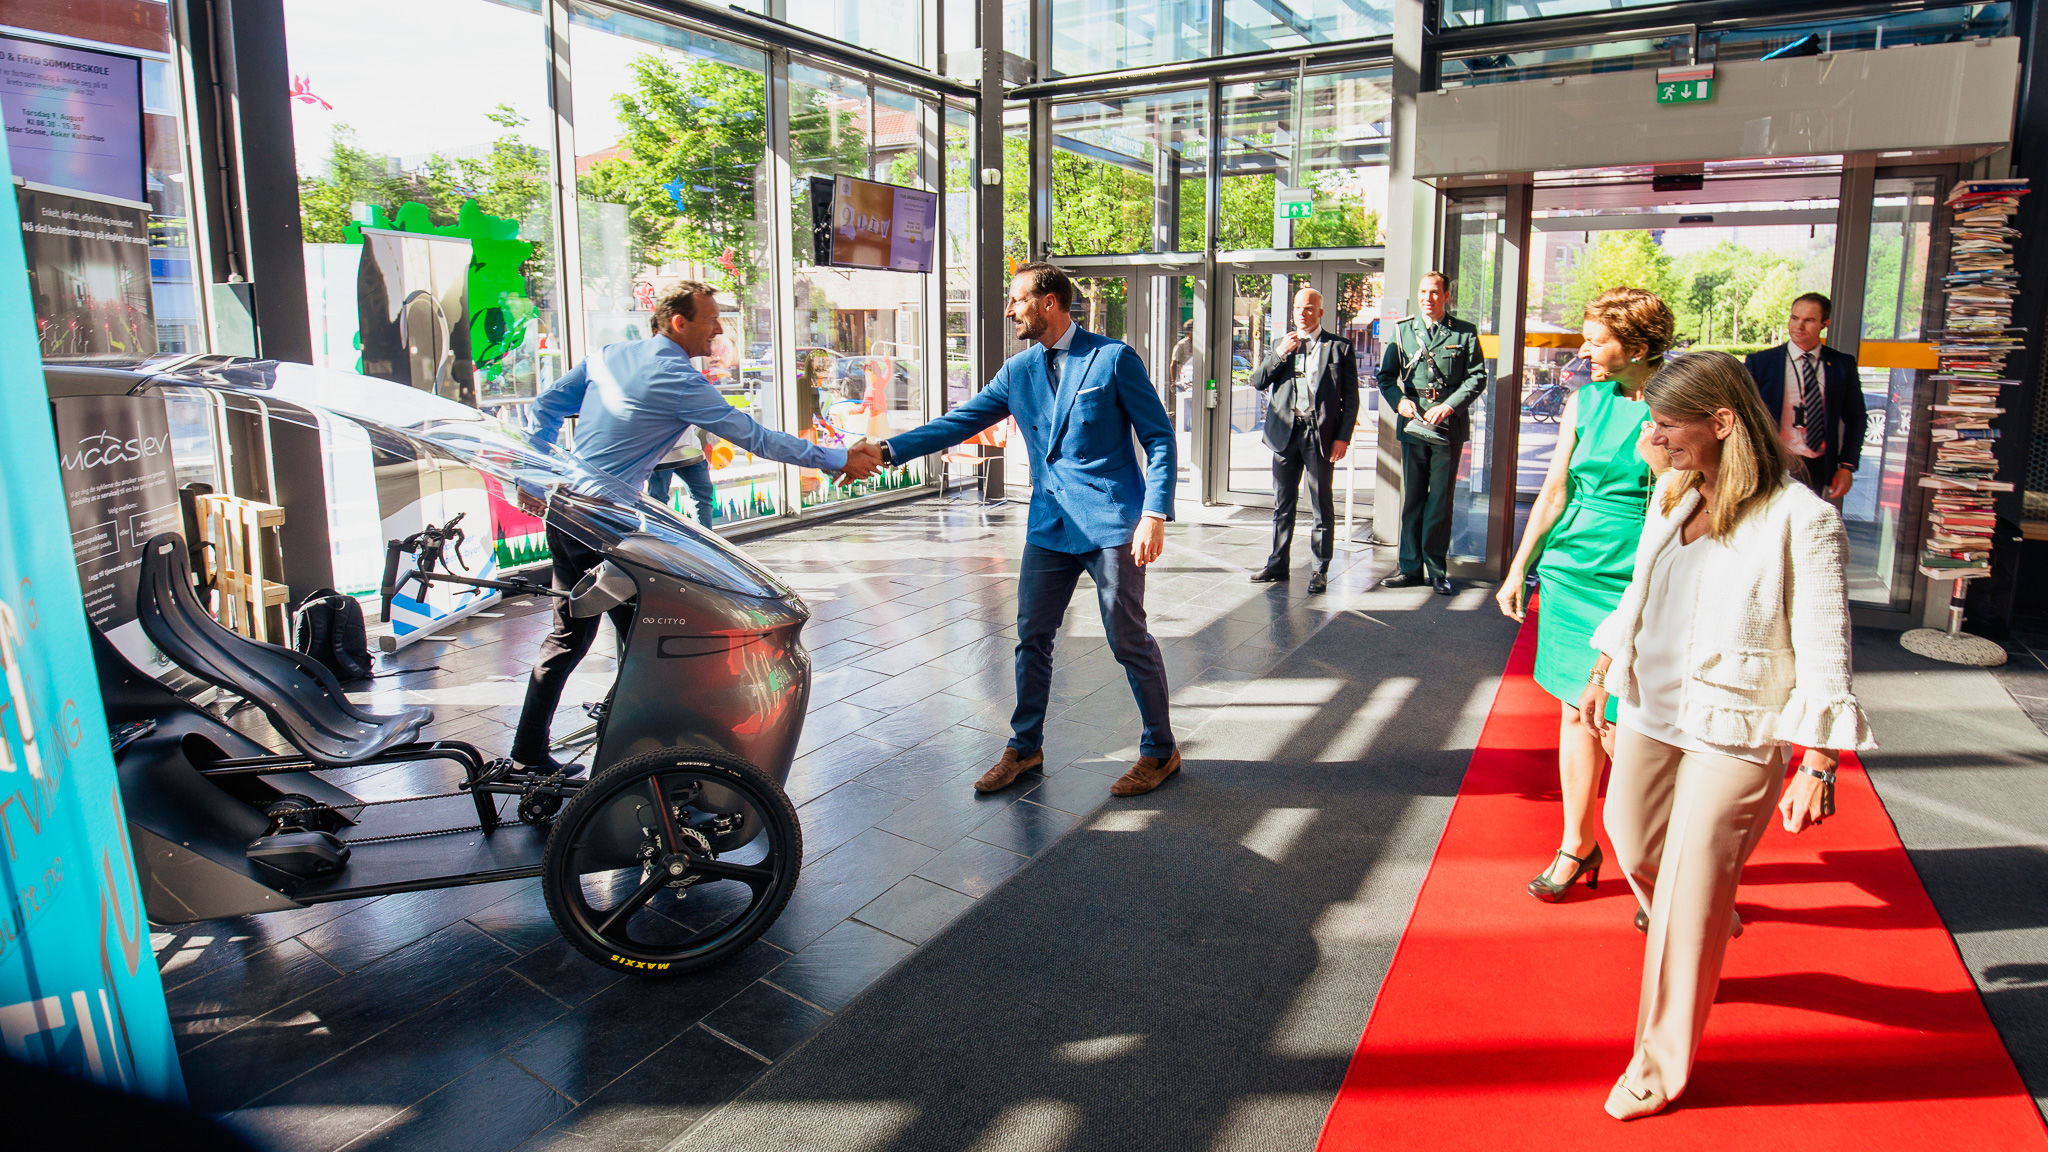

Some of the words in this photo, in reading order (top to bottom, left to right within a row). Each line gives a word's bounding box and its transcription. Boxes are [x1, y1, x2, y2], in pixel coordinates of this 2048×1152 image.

[8, 52, 14, 62] &
[17, 54, 41, 66] FRYD
[43, 57, 110, 76] SOMMERSKOLE
[22, 108, 50, 120] Torsdag
[60, 112, 84, 122] August
[50, 130, 70, 138] Asker
[72, 132, 105, 142] Kulturhus
[22, 221, 34, 232] Nå
[34, 223, 48, 233] skal
[96, 231, 104, 240] på
[108, 506, 119, 514] Velg
[610, 954, 671, 970] MAXXIS
